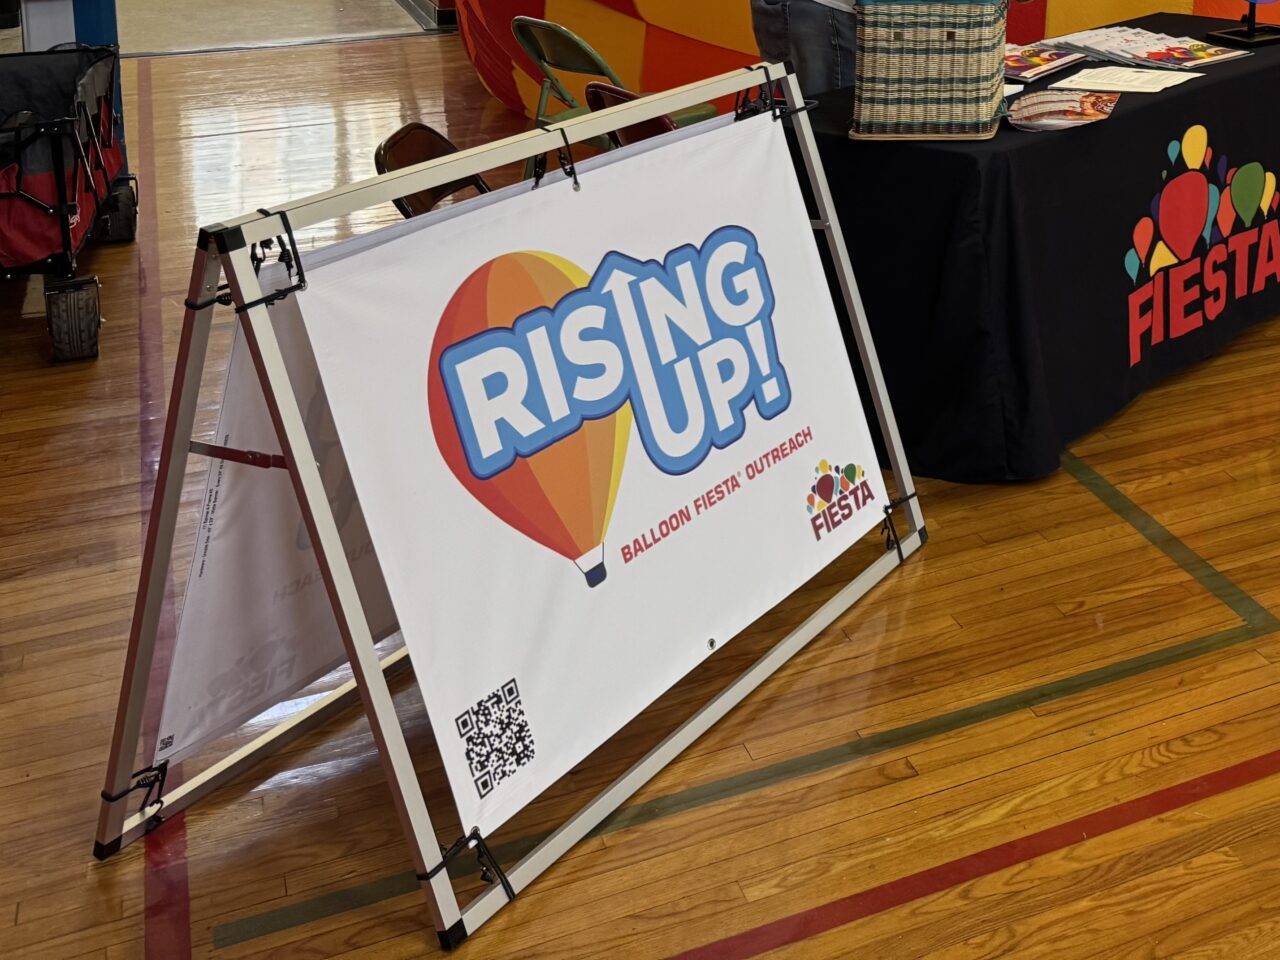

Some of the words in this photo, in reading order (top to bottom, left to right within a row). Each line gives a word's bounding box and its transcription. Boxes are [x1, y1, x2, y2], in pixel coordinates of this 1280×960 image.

[455, 240, 765, 460] RISING
[637, 319, 781, 458] UP!
[620, 504, 692, 564] BALLOON
[744, 426, 813, 481] OUTREACH
[809, 479, 875, 541] FIESTA
